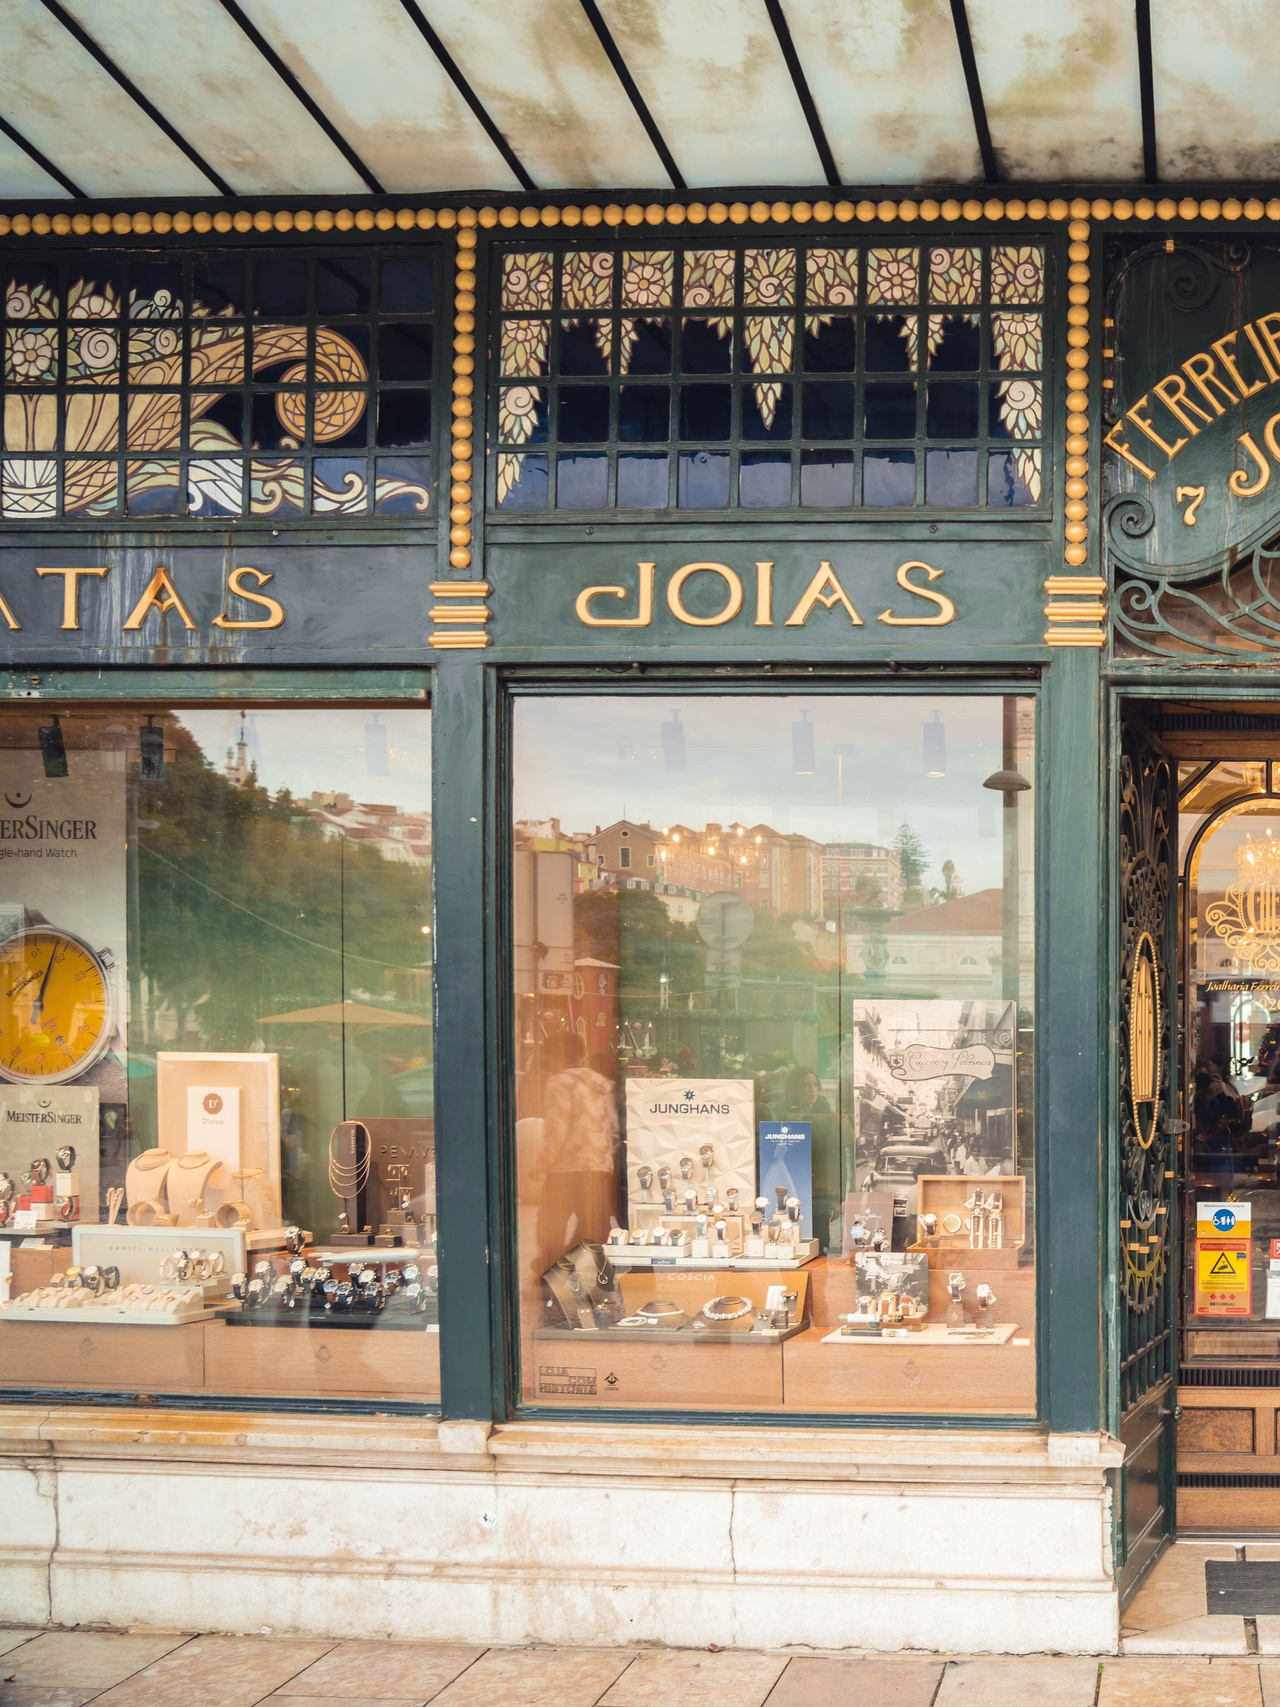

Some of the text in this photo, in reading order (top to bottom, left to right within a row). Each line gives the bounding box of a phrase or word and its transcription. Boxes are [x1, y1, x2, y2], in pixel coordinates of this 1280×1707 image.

[1175, 485, 1206, 527] 7
[0, 566, 286, 631] TAS
[575, 561, 957, 628] JOIAS
[46, 848, 78, 858] Watch
[1205, 981, 1249, 992] Joalharia
[649, 1103, 730, 1115] JUNGHANS
[668, 1273, 716, 1281] COSCIA
